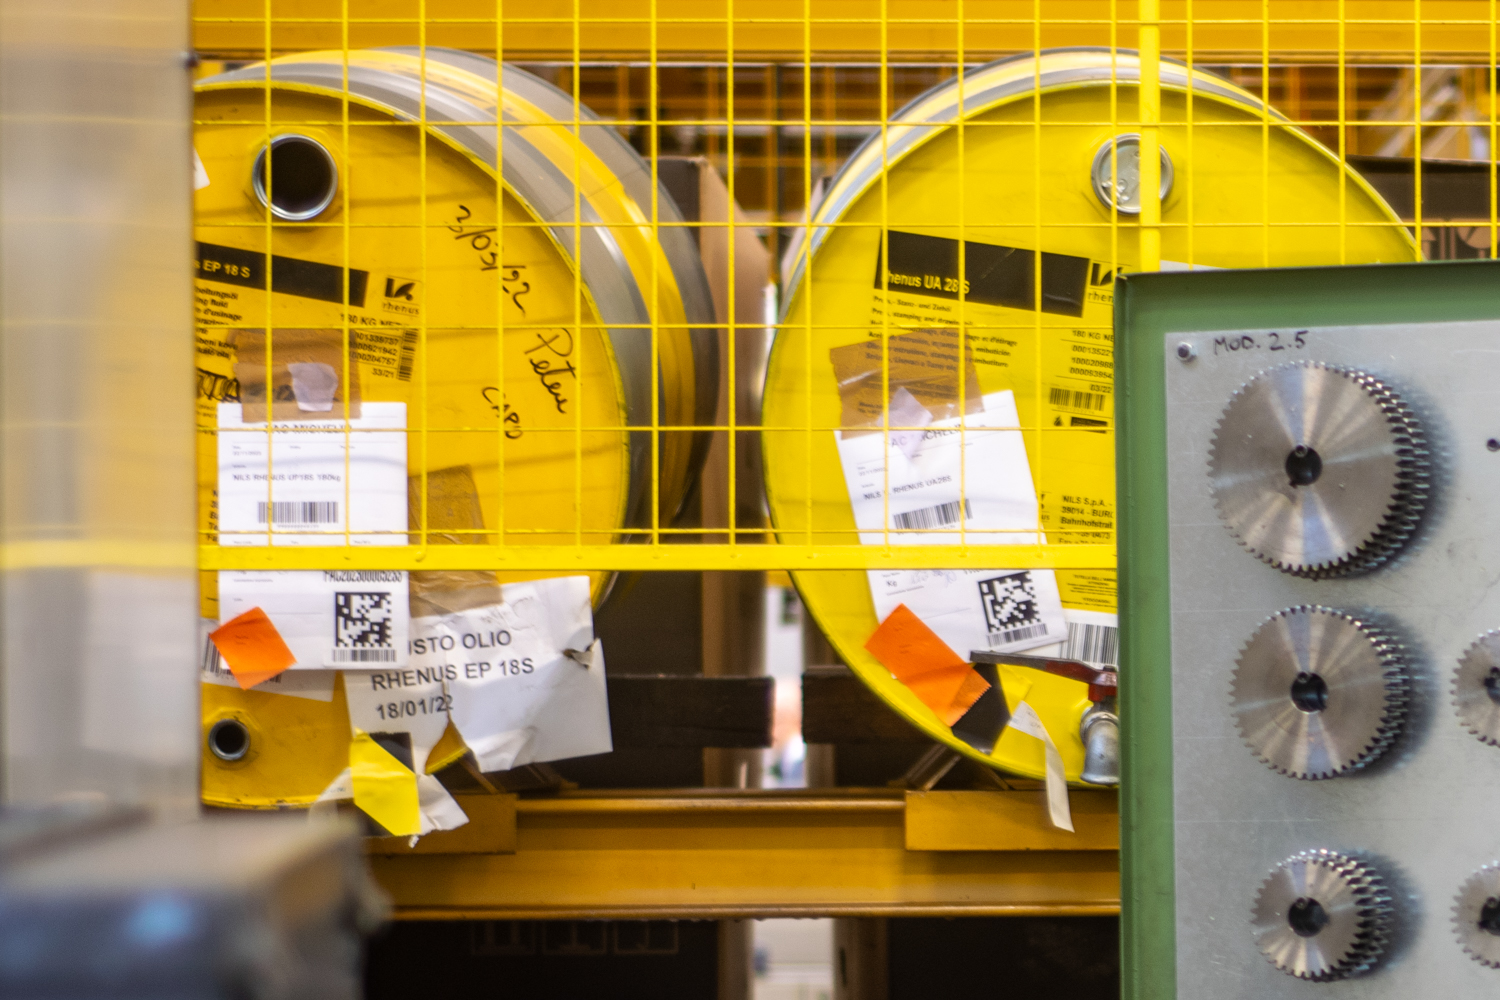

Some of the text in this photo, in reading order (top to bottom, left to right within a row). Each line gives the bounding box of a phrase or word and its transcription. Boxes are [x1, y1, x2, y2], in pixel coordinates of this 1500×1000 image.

[202, 259, 221, 273] EP
[224, 263, 239, 276] 18
[240, 266, 251, 279] S
[885, 270, 922, 288] henus
[923, 274, 942, 291] UA
[943, 277, 959, 293] 28
[382, 301, 420, 316] rhenus
[1213, 329, 1309, 356] MOD. 2.5
[462, 629, 513, 650] OLIO
[371, 657, 536, 692] RHENUS EP 18S
